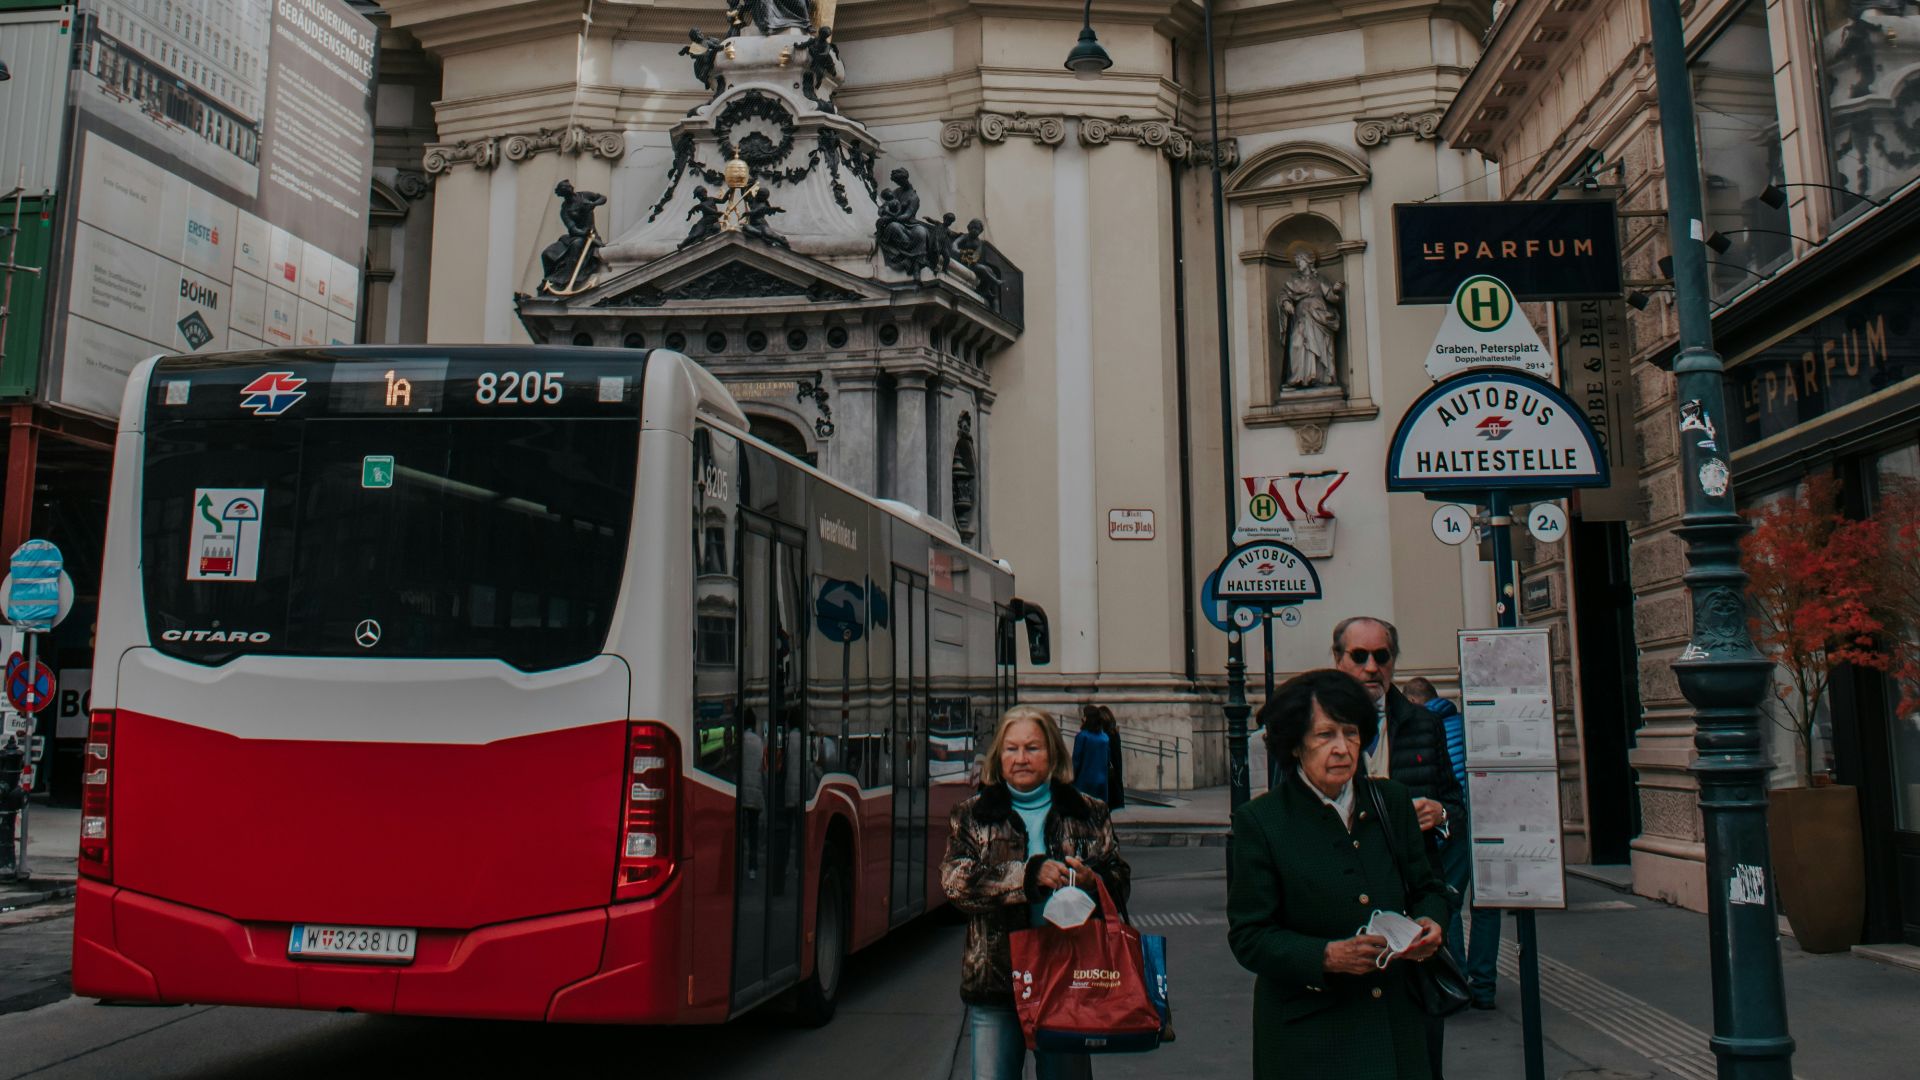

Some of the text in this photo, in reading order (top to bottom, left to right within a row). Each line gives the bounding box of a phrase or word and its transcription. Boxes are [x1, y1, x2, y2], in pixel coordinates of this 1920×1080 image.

[297, 0, 375, 58] ALISIERUNG DES
[278, 0, 374, 79] GEBÄUDEENSEMBLES
[188, 220, 211, 242] ERSTE
[1423, 238, 1594, 260] LE PARFUM
[1471, 287, 1500, 321] H
[1481, 343, 1539, 355] Petersplatz
[1455, 355, 1521, 364] Doppelhaltestelle
[1525, 362, 1546, 370] 2914
[1583, 357, 1602, 373] &
[1765, 314, 1888, 413] PARFUM
[384, 369, 411, 406] 1A
[475, 371, 564, 405] 8205
[1437, 387, 1554, 427] AUTOBUS
[1417, 448, 1577, 473] HALTESTELLE
[706, 465, 728, 501] 8205
[1256, 499, 1271, 516] H
[1443, 516, 1461, 533] 1A
[1537, 515, 1559, 531] 2A
[1238, 549, 1296, 569] AUTOBUS
[1227, 580, 1307, 591] HALTESTELLE
[1239, 613, 1248, 621] 1A
[1285, 613, 1296, 621] 2A
[162, 629, 271, 643] CITARO
[11, 719, 27, 728] End
[1073, 968, 1121, 980] EDUSCHO
